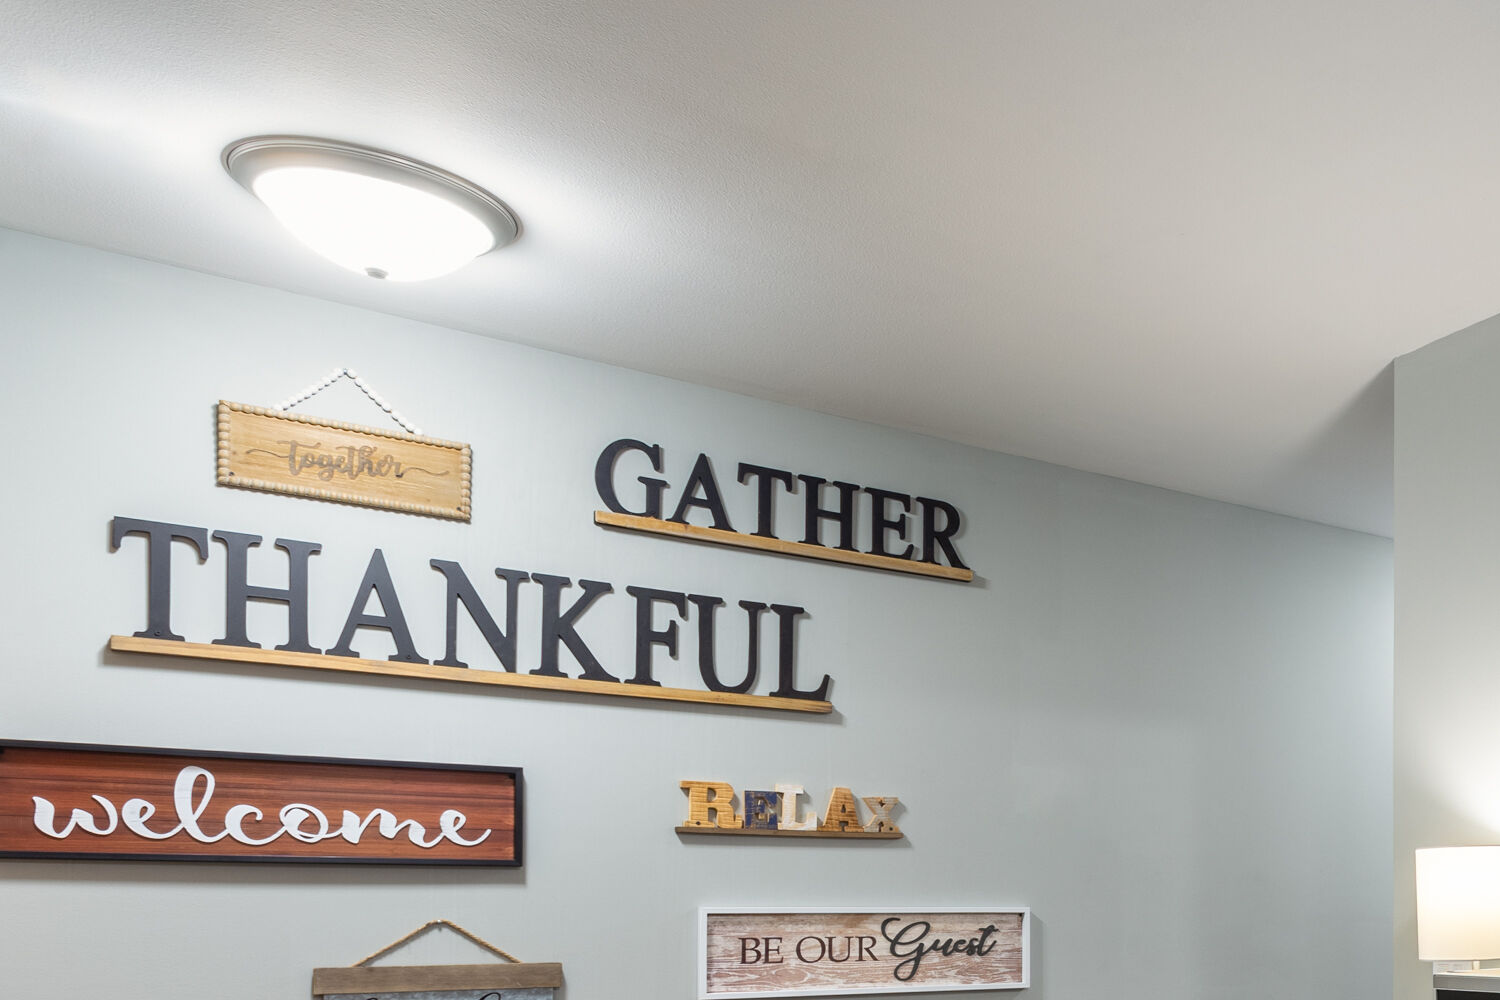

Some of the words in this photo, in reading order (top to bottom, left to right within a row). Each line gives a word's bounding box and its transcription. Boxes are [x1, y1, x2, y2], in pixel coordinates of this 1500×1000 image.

[596, 438, 966, 570] GATHER
[112, 516, 834, 703] THANKFUL
[32, 765, 492, 848] welcome
[679, 780, 901, 833] RELAX
[738, 936, 784, 964] BE
[795, 935, 880, 964] OUR
[880, 917, 1000, 982] Guest
